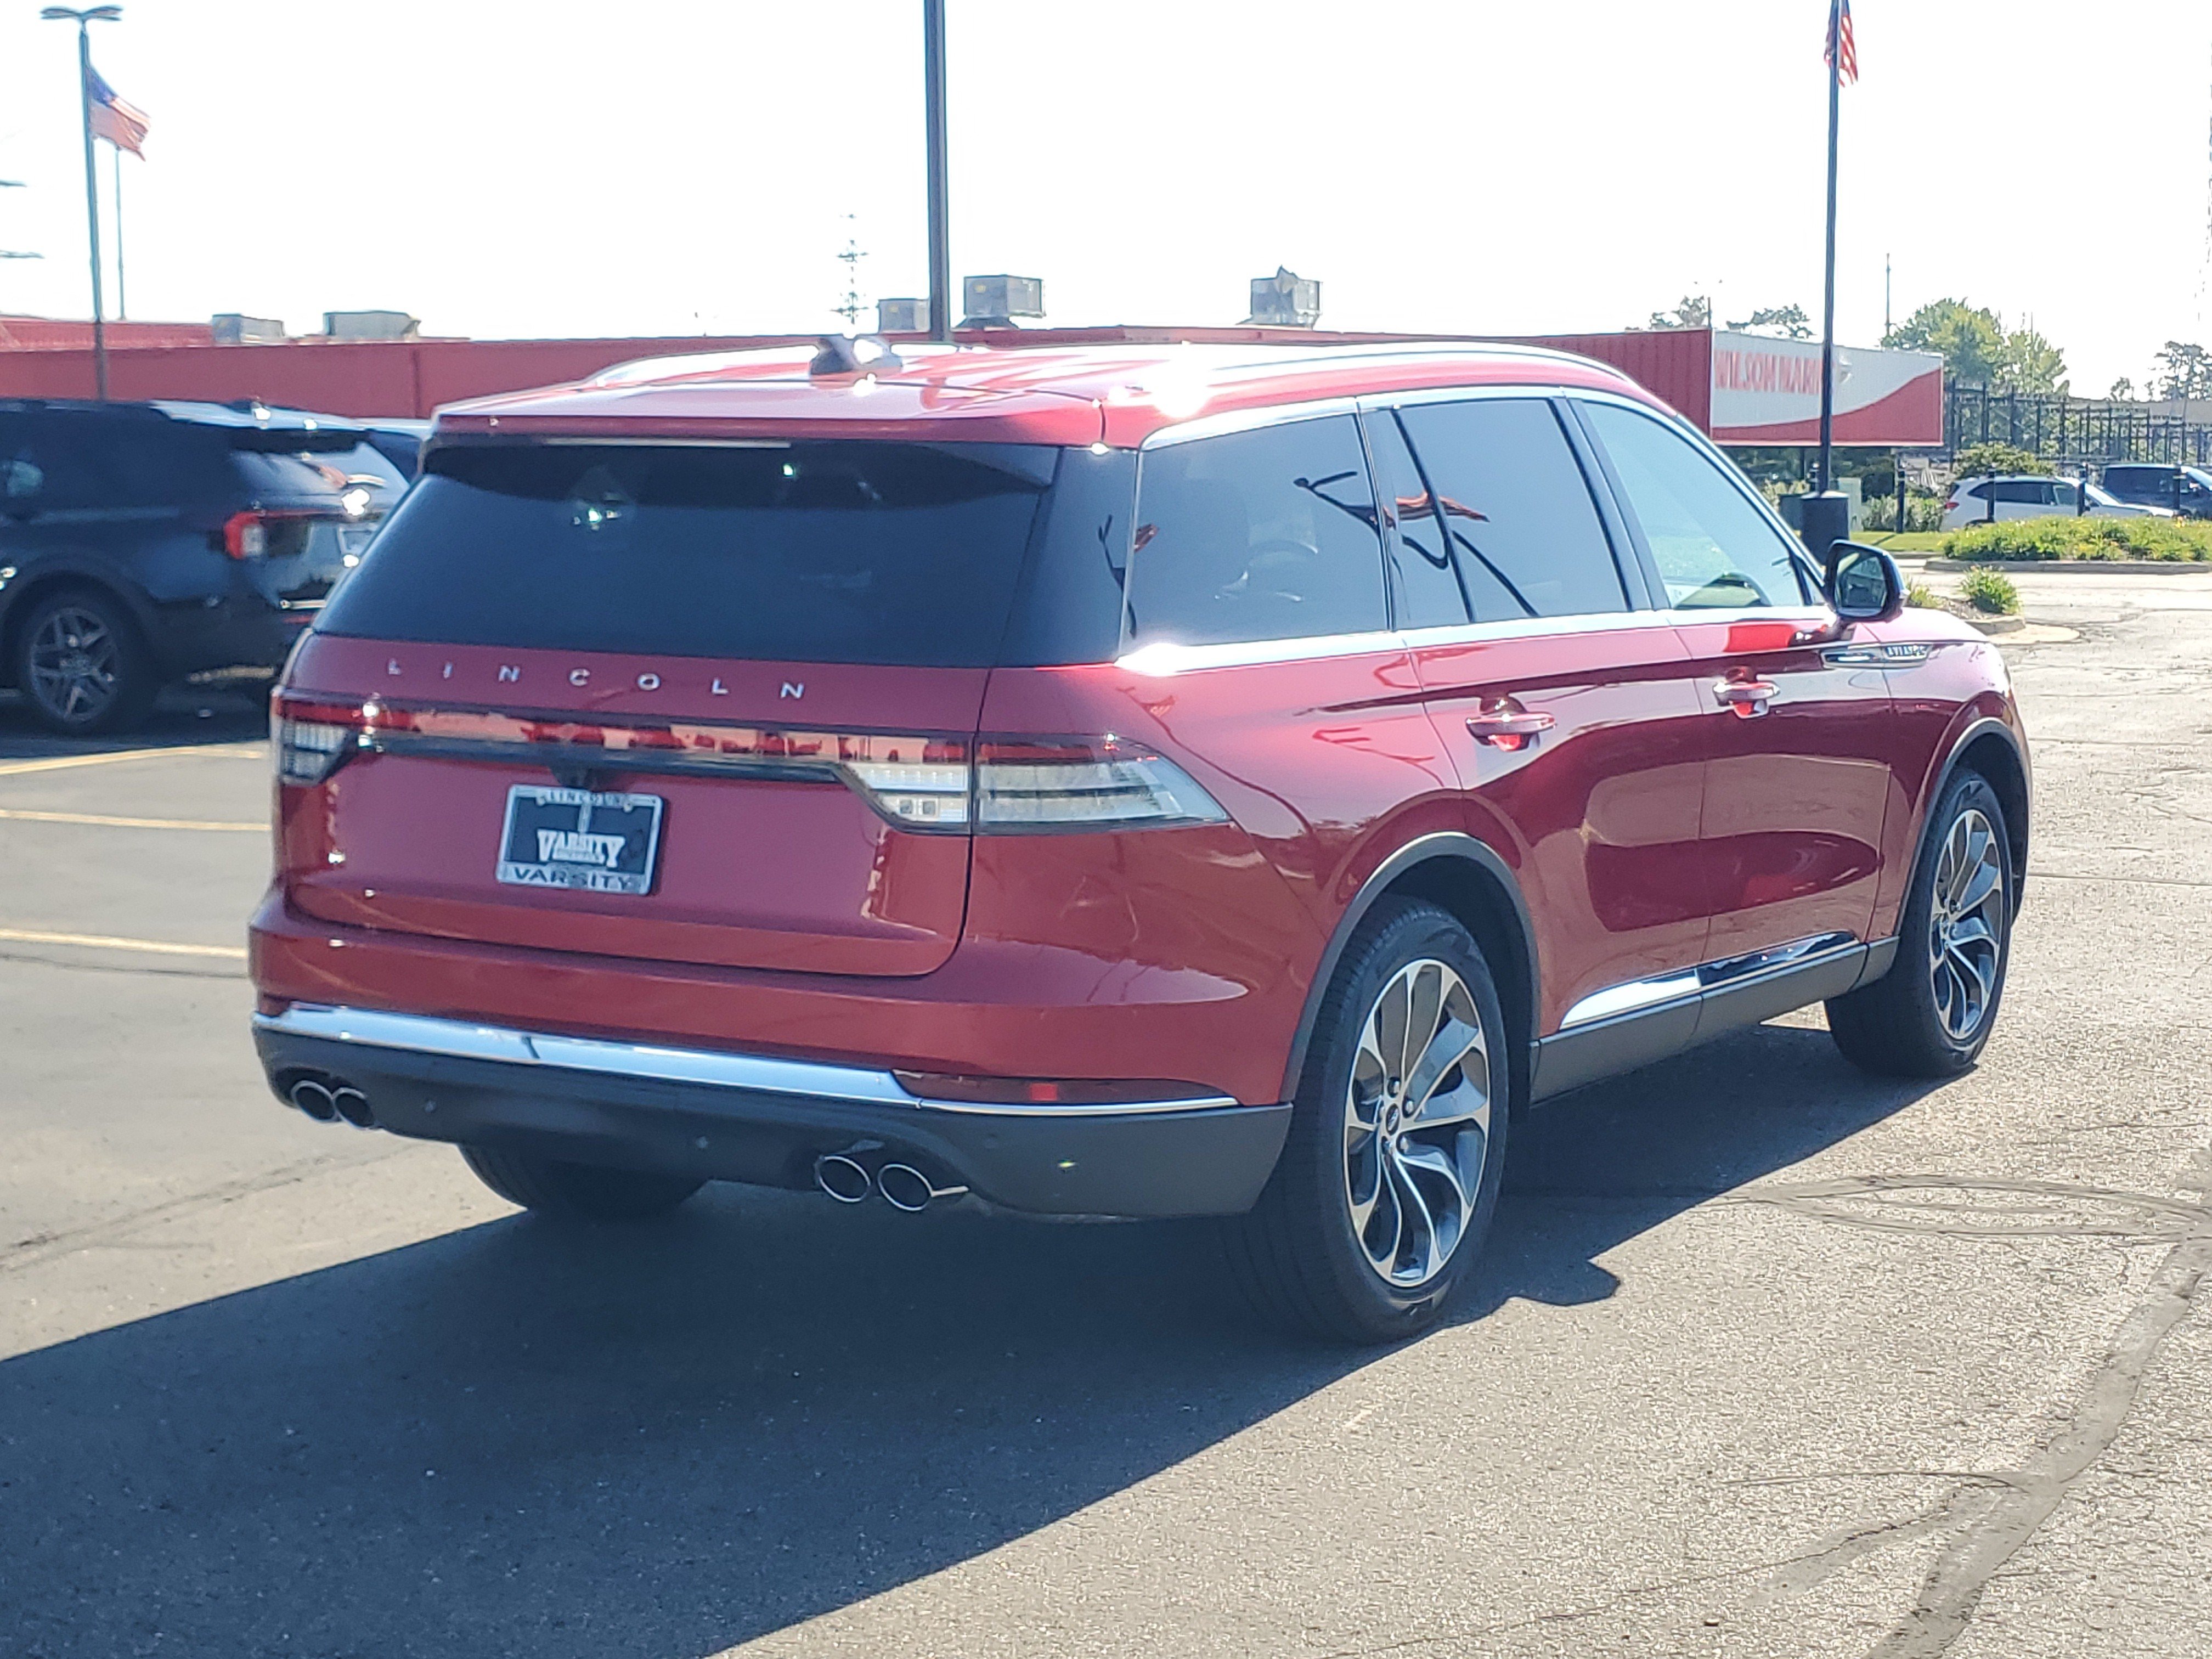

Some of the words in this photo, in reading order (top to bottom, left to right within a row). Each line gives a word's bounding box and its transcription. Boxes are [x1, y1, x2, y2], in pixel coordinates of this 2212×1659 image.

[1713, 350, 1776, 392] WILSON
[387, 659, 805, 699] LINCOLN
[514, 866, 634, 890] VARSITY
